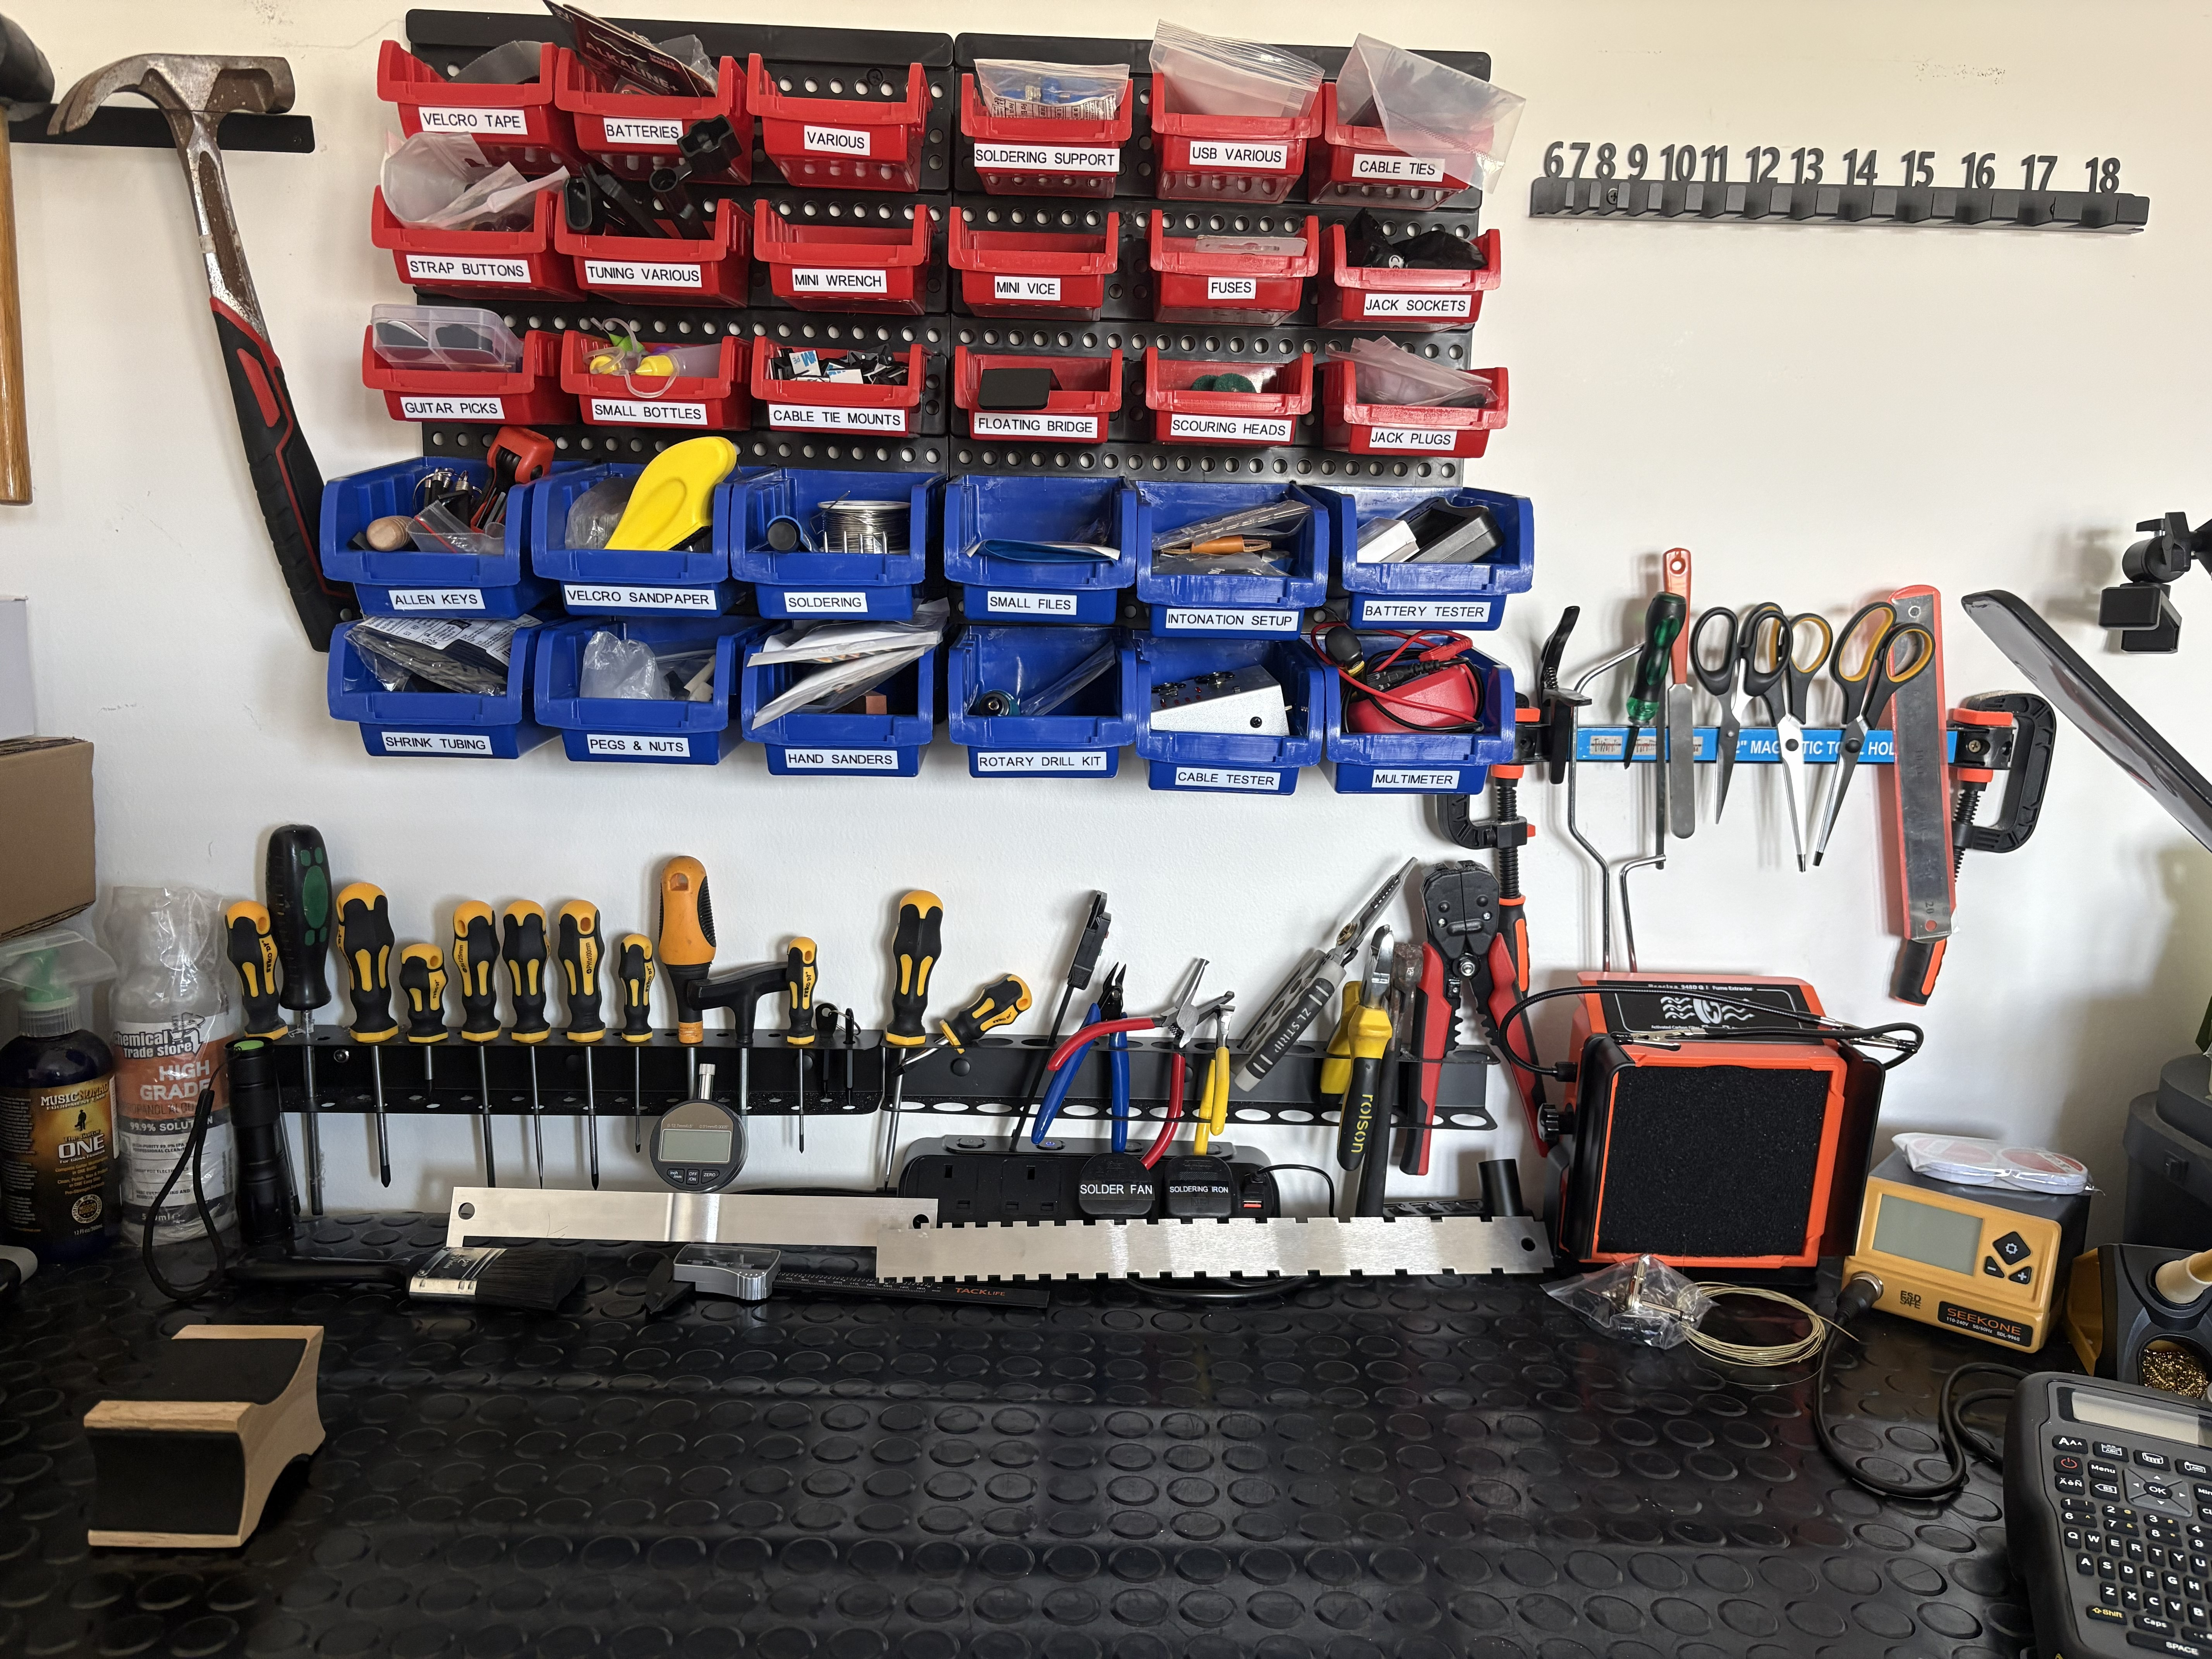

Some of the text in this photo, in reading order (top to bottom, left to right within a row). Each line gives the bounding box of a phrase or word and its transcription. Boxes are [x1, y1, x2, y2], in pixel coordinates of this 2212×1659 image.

[423, 113, 521, 128] VELCRO TAPE
[606, 124, 679, 139] BATTERIES
[807, 131, 864, 149] VARIOUS
[976, 149, 1115, 166] SOLDERING SUPPORT
[1193, 147, 1281, 163] USB VARIOUS
[1360, 160, 1436, 176] CABLE TIES
[1544, 141, 2121, 193] 6 7 8 9 10 11 12 13 14 15 16 17 18
[410, 261, 524, 277] STRAP BUTTONS
[587, 266, 699, 282] TUNING VARIOUS
[795, 274, 881, 287] MINI WRENCH
[1211, 282, 1251, 293] FUSES
[997, 282, 1055, 295] MINI VICE
[1366, 299, 1465, 311] JACK SOCKETS
[405, 402, 498, 414] GUITAR PICKS
[595, 404, 701, 419] SMALL BOTTLES
[773, 410, 900, 426] CABLE TIE MOUNTS
[979, 417, 1092, 433] FLOATING BRIDGE
[1172, 420, 1285, 436] SCOURING HEADS
[1371, 432, 1451, 445] JACK PLUGS
[395, 594, 477, 605] ALLEN KEYS
[567, 590, 709, 605] VELCRO SANDPAPER
[789, 598, 861, 607] SOLDERING
[990, 596, 1071, 610] SMALL FILES
[1365, 606, 1484, 617] BATTERY TESTER
[1168, 614, 1292, 626] INTONATION SETUP
[385, 737, 486, 750] SHRINK TUBING
[590, 739, 684, 752] PEGS & NUTS
[1750, 740, 1823, 754] MAGTIC
[1869, 742, 1894, 755] HOL
[788, 754, 892, 764] HAND SANDERS
[979, 756, 1101, 766] ROTARY DRILL KIT
[1178, 772, 1274, 785] CABLE TESTER
[1375, 774, 1453, 784] MULTIMETER
[159, 1060, 210, 1082] HIGH
[140, 1078, 211, 1101] GRADE
[130, 1116, 213, 1132] 99.9% SOLUTN
[1351, 1094, 1374, 1153] rolson
[58, 1134, 105, 1159] ONE
[1080, 1184, 1153, 1195] SOLDER FAN
[956, 1288, 1005, 1296] TACKLIFE
[1900, 1290, 1921, 1303] ESD
[1946, 1317, 1969, 1327] 110-240V
[1972, 1324, 1992, 1333] 50/60Hz
[1947, 1308, 2021, 1336] SEEKONE
[2091, 1465, 2116, 1474] Menu
[2149, 1486, 2167, 1495] OK
[2068, 1532, 2078, 1540] Q
[2088, 1534, 2100, 1543] W
[2131, 1543, 2142, 1552] R
[2152, 1548, 2162, 1556] T
[2173, 1553, 2184, 1561] Y
[2195, 1559, 2206, 1567] U
[2081, 1558, 2091, 1566] A
[2102, 1561, 2111, 1570] S
[2124, 1566, 2133, 1574] D
[2167, 1577, 2178, 1585] G
[2189, 1581, 2200, 1590] H
[2105, 1587, 2204, 1617] Z X C V B
[2102, 1609, 2123, 1618] Shift
[2143, 1617, 2167, 1628] Caps
[2166, 1641, 2200, 1656] SPACE
